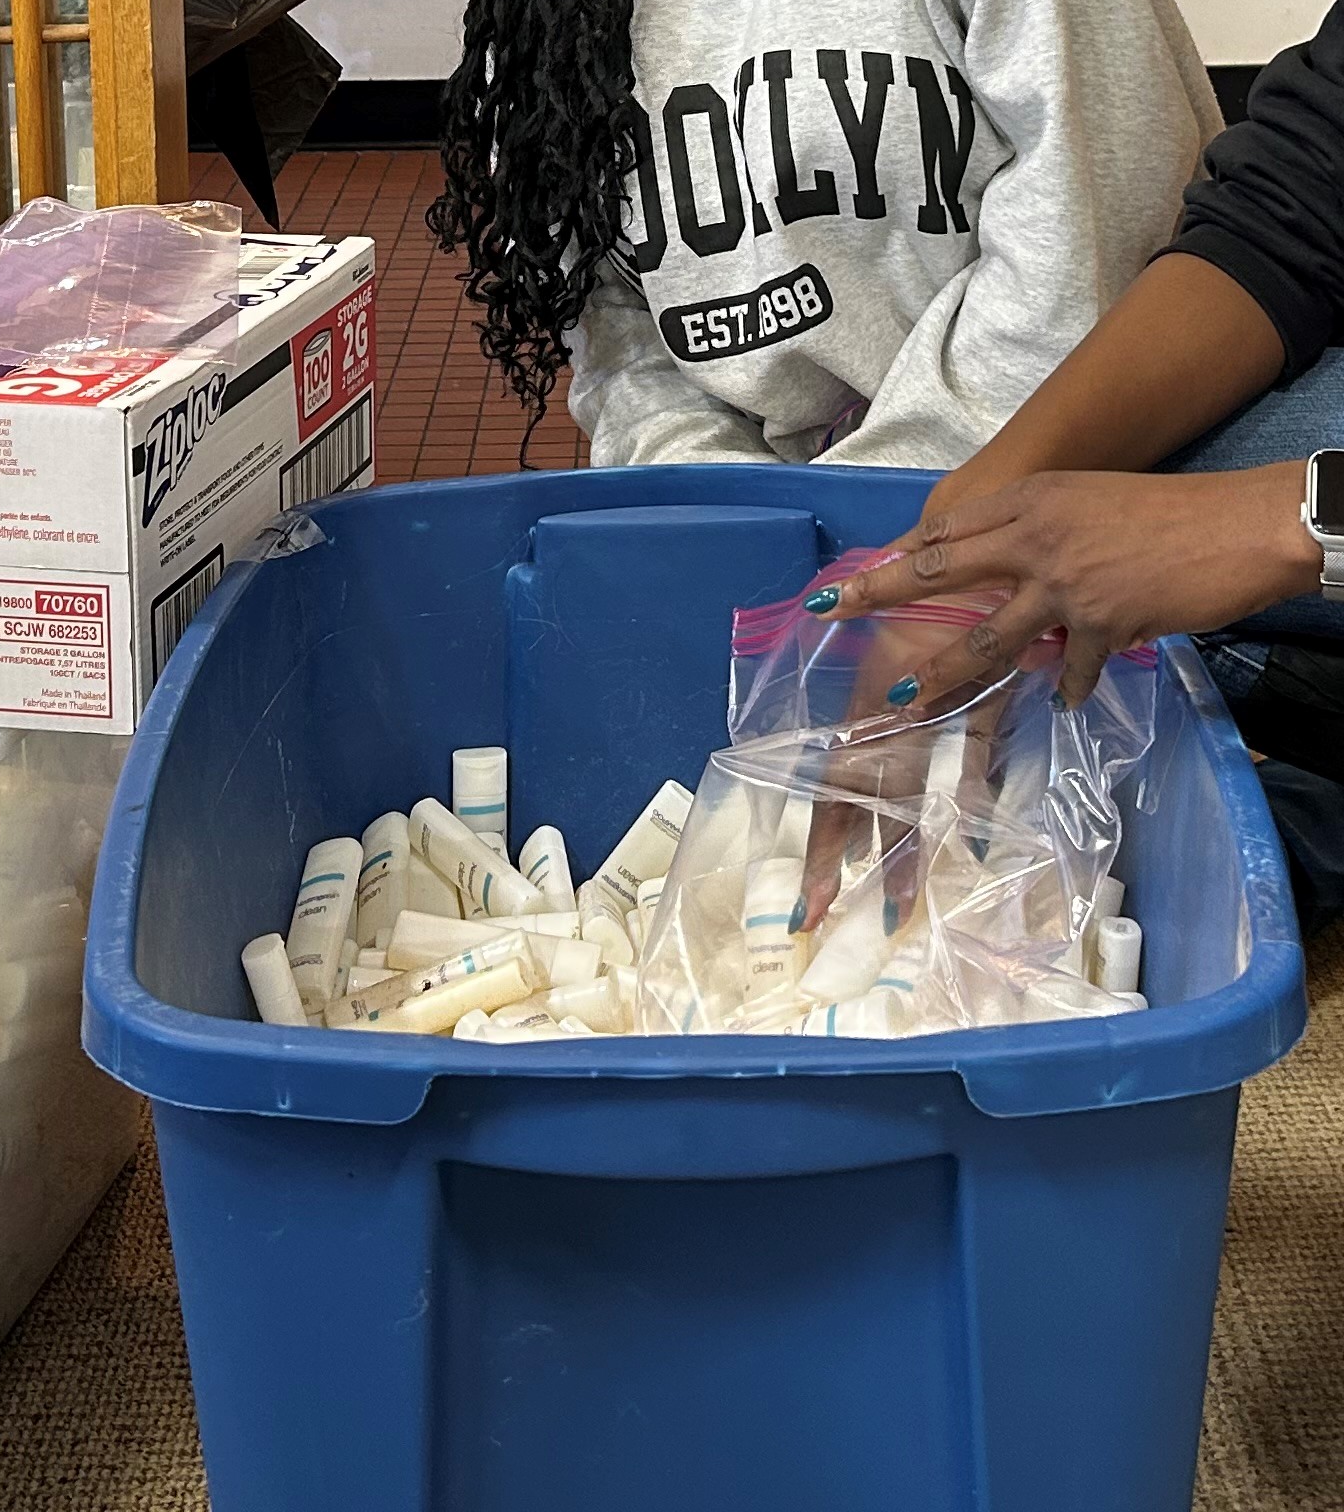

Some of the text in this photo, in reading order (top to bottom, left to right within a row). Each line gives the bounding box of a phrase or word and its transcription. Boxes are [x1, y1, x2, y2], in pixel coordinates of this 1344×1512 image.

[337, 285, 372, 327] STORAGE
[681, 303, 752, 353] EST.
[343, 310, 369, 372] 2G
[306, 349, 330, 394] 100
[347, 356, 370, 389] GALLON
[307, 382, 330, 411] COUNT
[143, 372, 227, 524] Ziploc
[33, 528, 65, 542] colorant
[66, 530, 75, 543] et
[76, 532, 101, 544] encre.
[39, 594, 98, 615] 70760
[3, 620, 98, 641] SCJW 682253
[19, 646, 106, 660] STORAGE 2 GALLON
[57, 659, 74, 669] 7,57
[75, 660, 106, 670] LITRES
[82, 670, 106, 680] BACS
[22, 697, 68, 710] Fabriqué en
[41, 687, 106, 701] Made in Thailand
[617, 864, 642, 889] clean
[751, 960, 785, 975] clean
